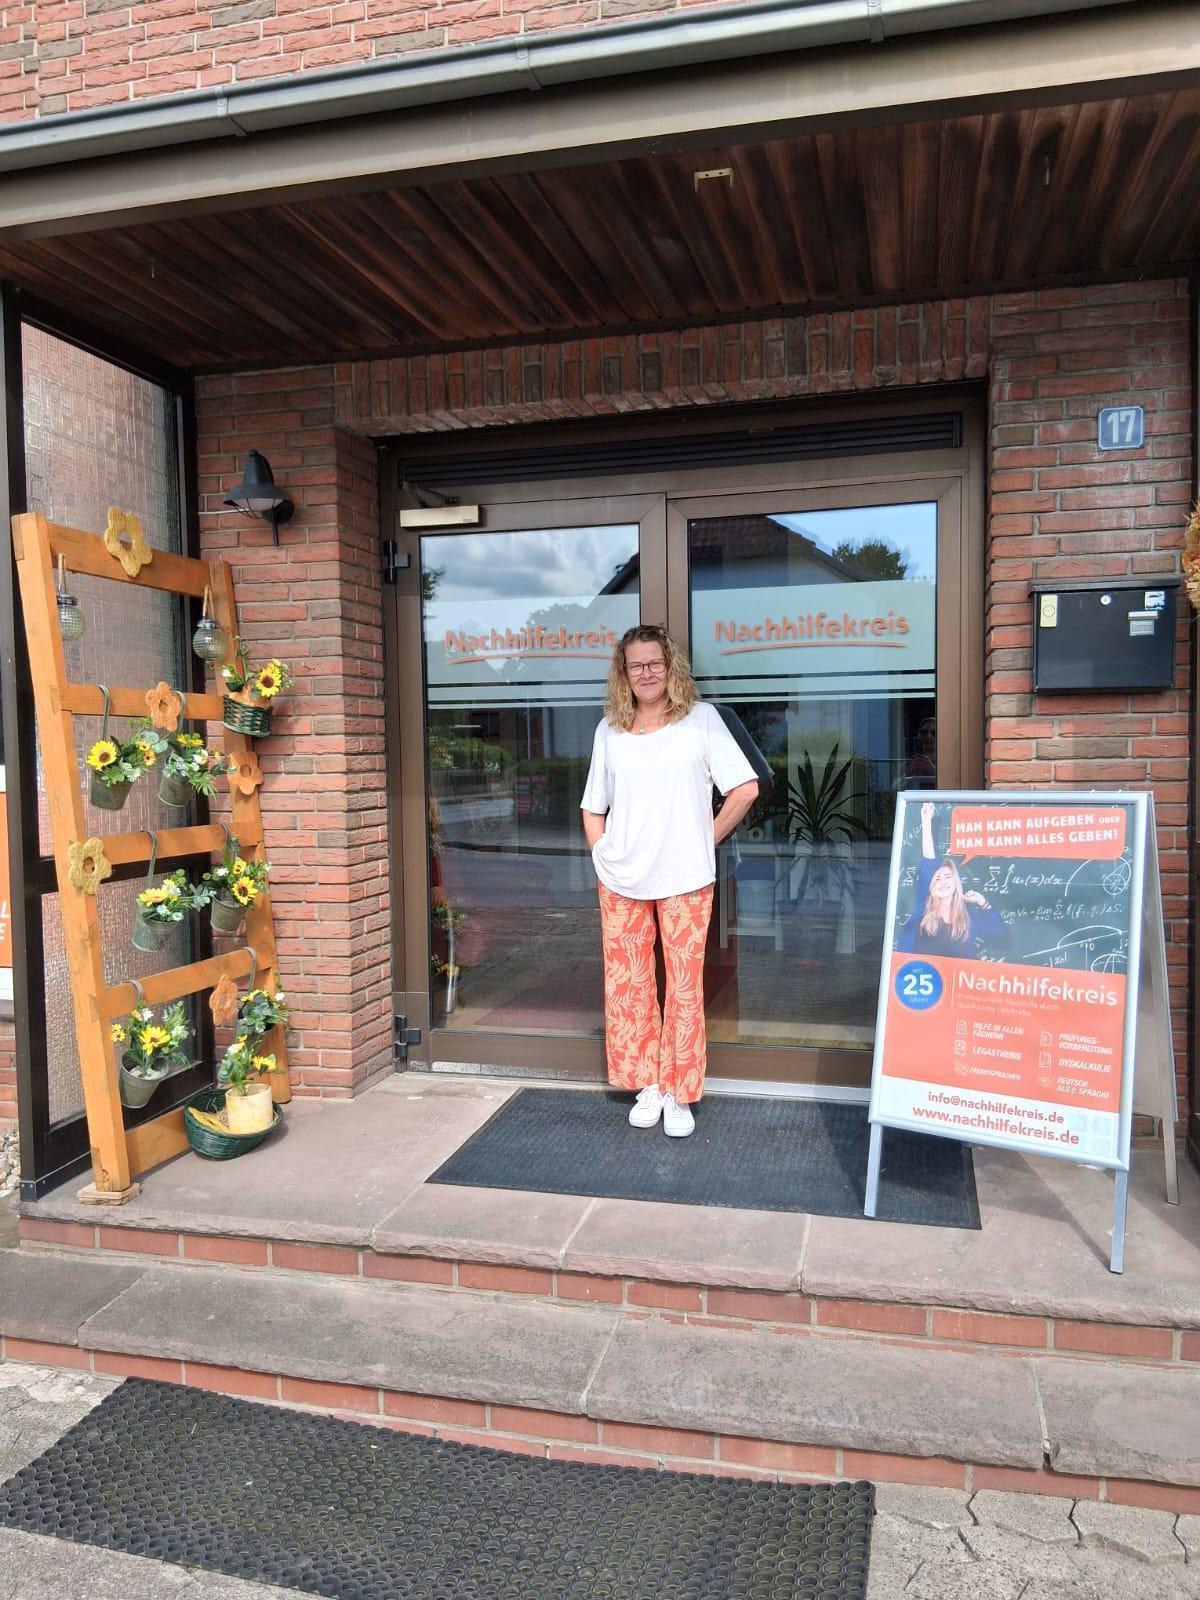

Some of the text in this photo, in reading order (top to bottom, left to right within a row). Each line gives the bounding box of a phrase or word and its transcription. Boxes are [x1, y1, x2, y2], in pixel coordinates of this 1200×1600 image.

[1107, 410, 1137, 443] 17
[714, 608, 910, 642] Nachhilfekreis
[955, 814, 1121, 833] MAN KANN AUFGEBEN ODER
[955, 829, 1119, 849] MAN KANN ALLES GEBEN!
[903, 974, 934, 995] 25
[958, 971, 1118, 1007] Nachhilfekreis
[1001, 1025, 1024, 1035] ALLEN
[972, 1046, 1023, 1060] LEGASTHENIE
[1058, 1042, 1113, 1055] VORBEREITUNG
[1058, 1058, 1112, 1073] DYSKALKULIE
[927, 1091, 1065, 1124] info@nachhilfekreis.de
[912, 1106, 1080, 1145] www.nachhilfekreis.de
